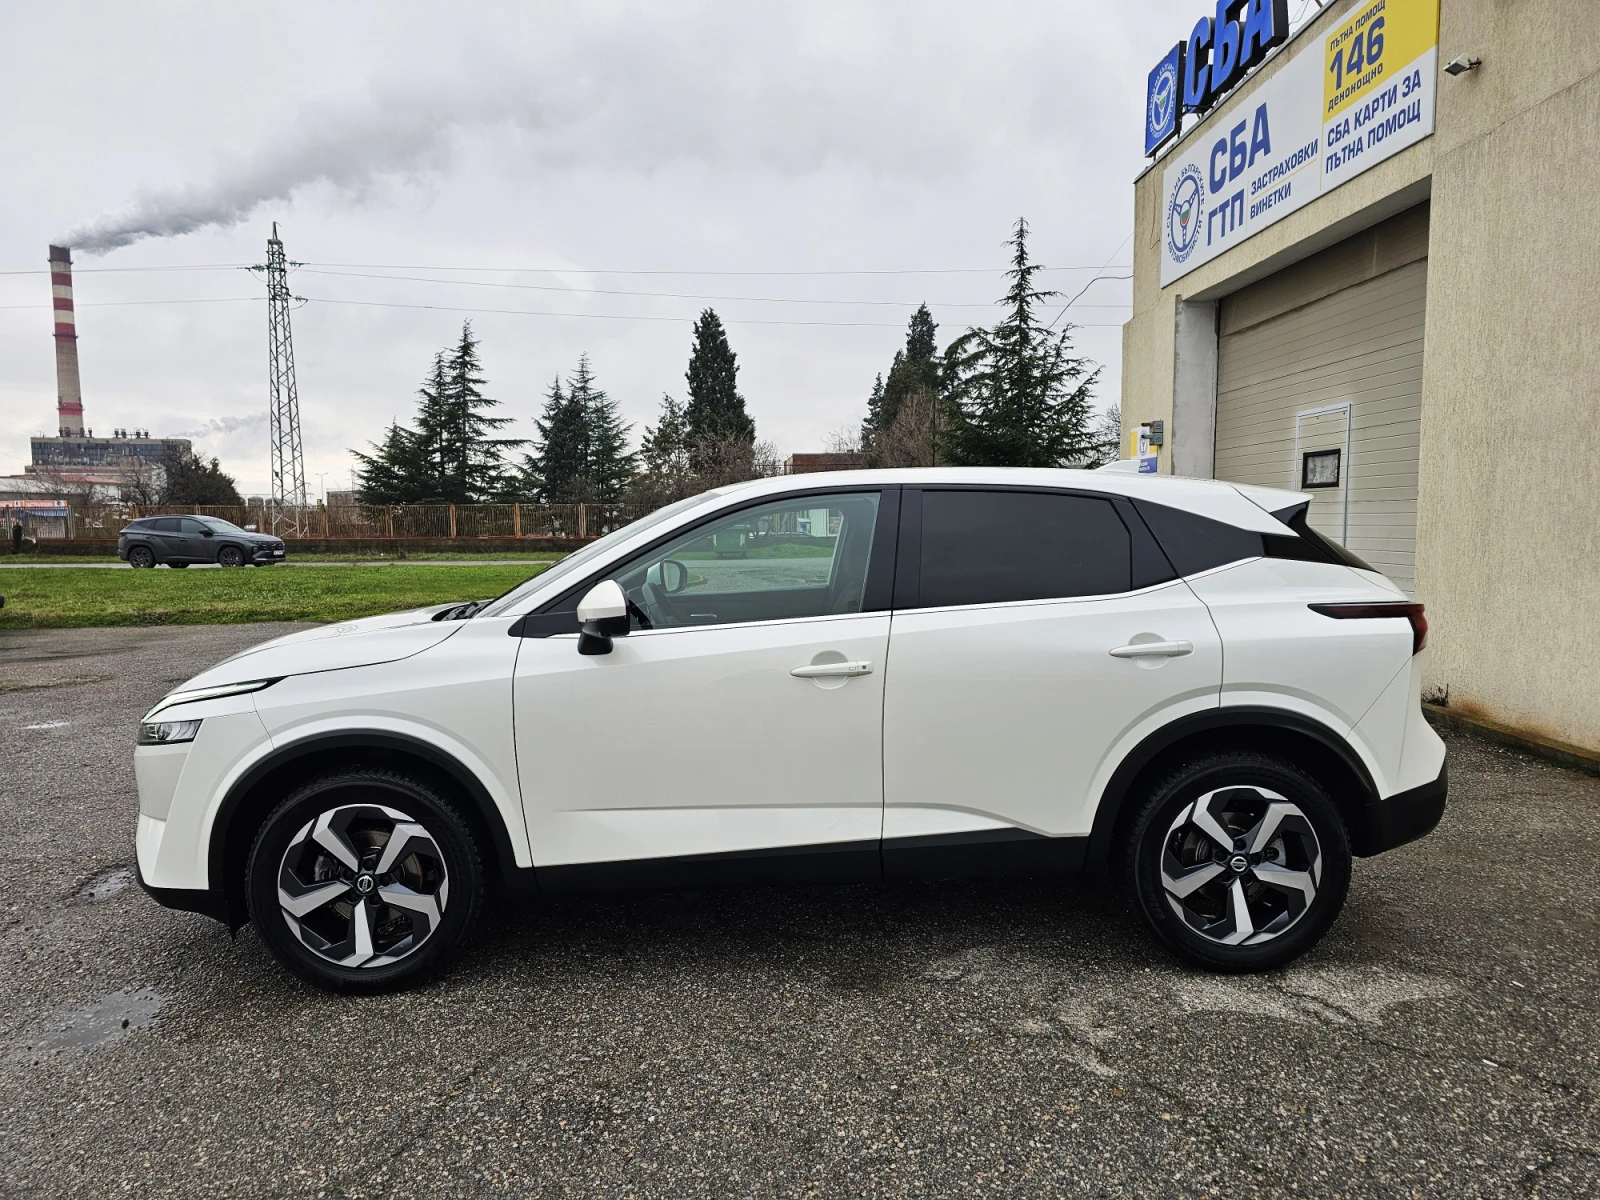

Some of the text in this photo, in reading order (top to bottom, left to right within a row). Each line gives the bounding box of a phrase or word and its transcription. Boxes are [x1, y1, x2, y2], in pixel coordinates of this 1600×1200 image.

[1329, 15, 1385, 91] 146
[1330, 0, 1386, 52] ПЪТНА ПОМОЩ
[1184, 0, 1275, 113] СБА
[1327, 62, 1383, 113] денонощно
[1327, 69, 1421, 147] СБА КАРТИ ЗА
[1209, 101, 1271, 194] СБА
[1326, 98, 1421, 174] ПЪТНА ПОМОЩ
[1250, 138, 1319, 196] ЗАСТРАХОВКИ
[1166, 192, 1175, 229] СЪЮЗ
[1173, 176, 1181, 191] НА
[1207, 188, 1245, 247] ГТП
[1249, 181, 1292, 220] ВИНЕТКИ
